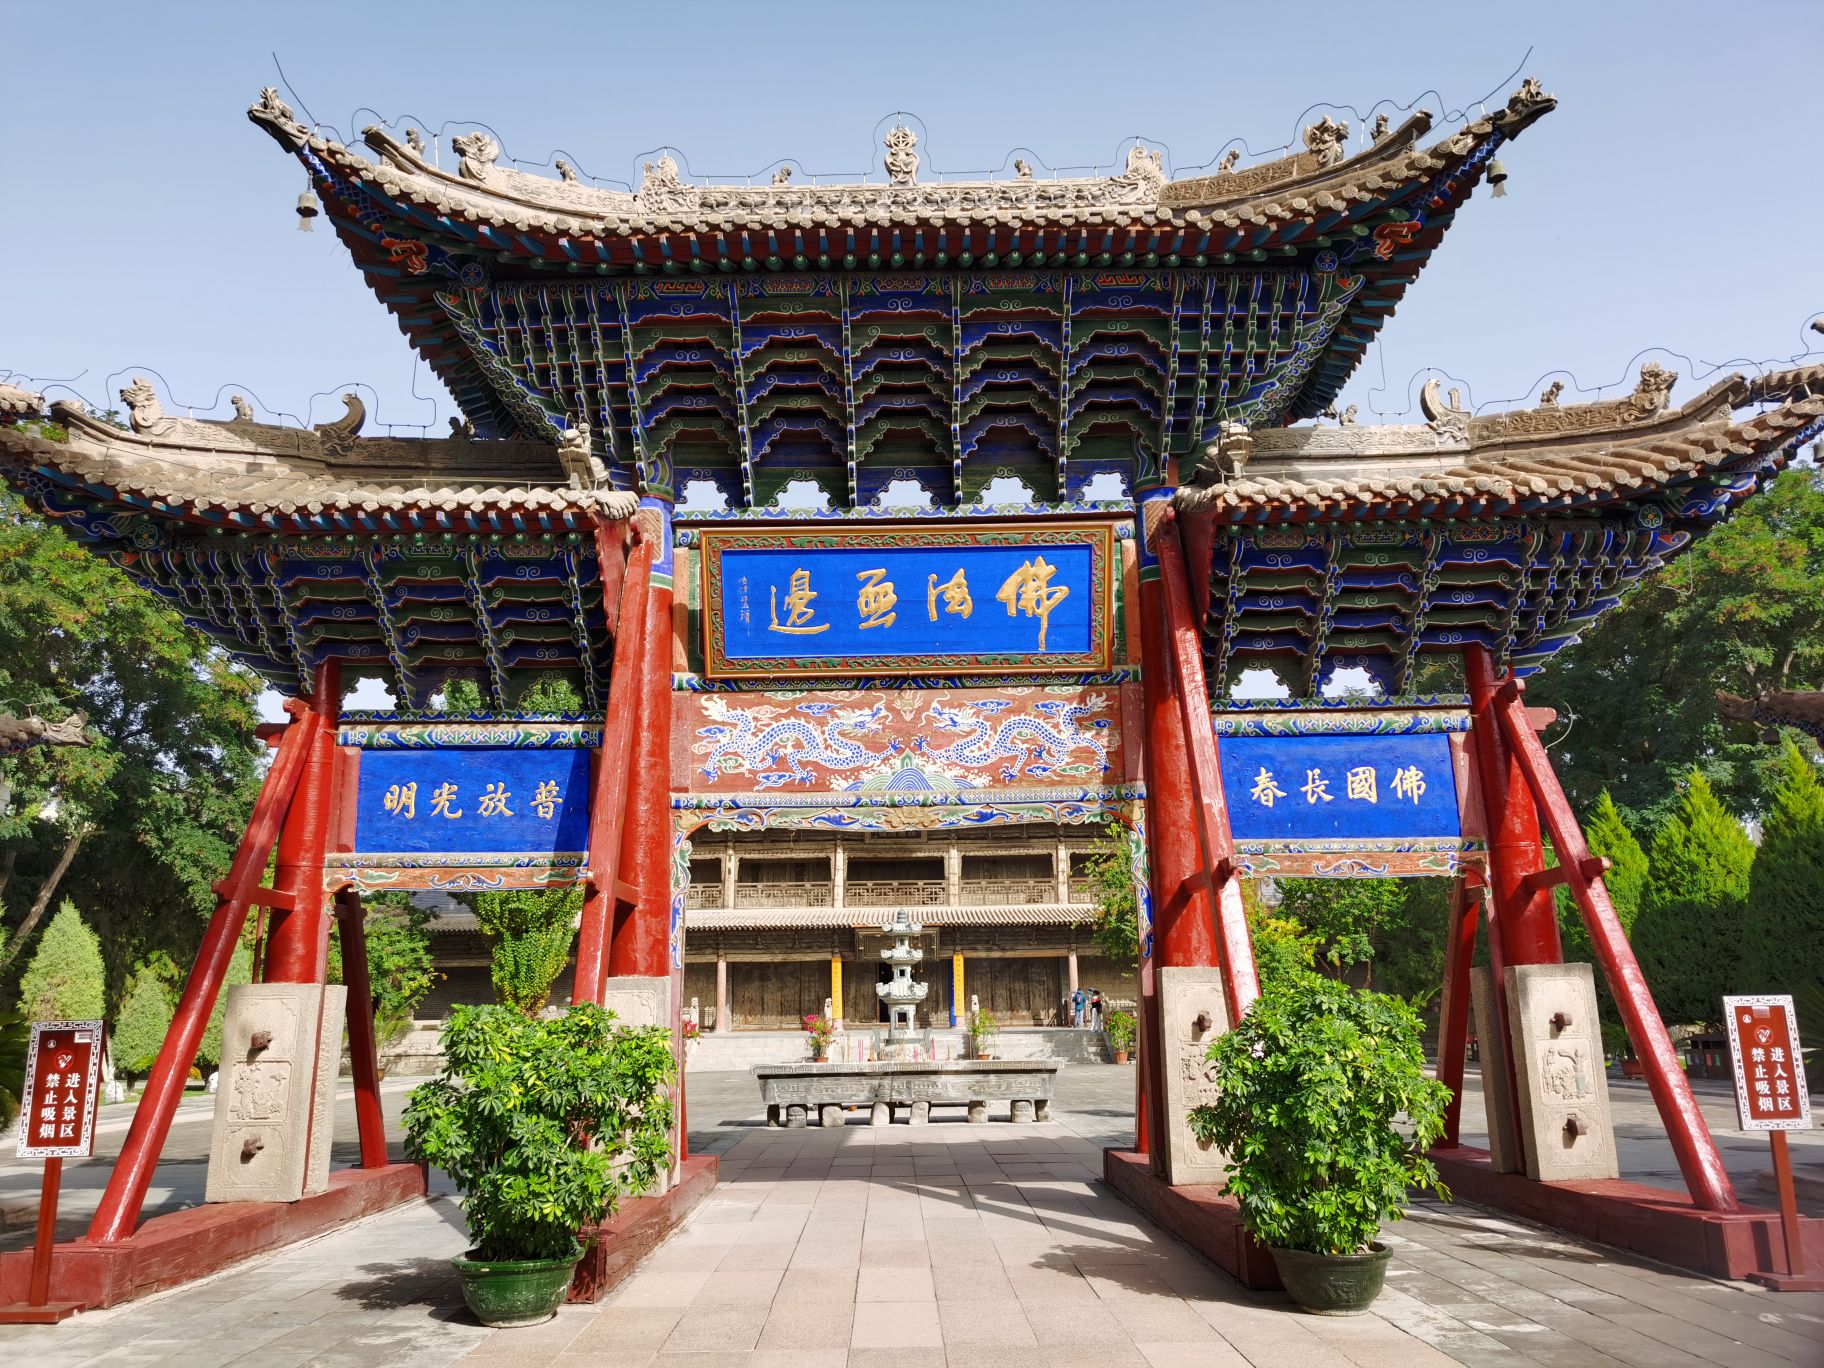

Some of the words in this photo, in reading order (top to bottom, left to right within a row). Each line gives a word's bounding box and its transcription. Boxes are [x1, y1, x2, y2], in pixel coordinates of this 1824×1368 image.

[39, 1073, 61, 1138] 禁止吸烟
[59, 1073, 81, 1138] 进入景区
[1751, 1047, 1773, 1112] 禁止吸烟
[1770, 1047, 1792, 1111] 进入景区
